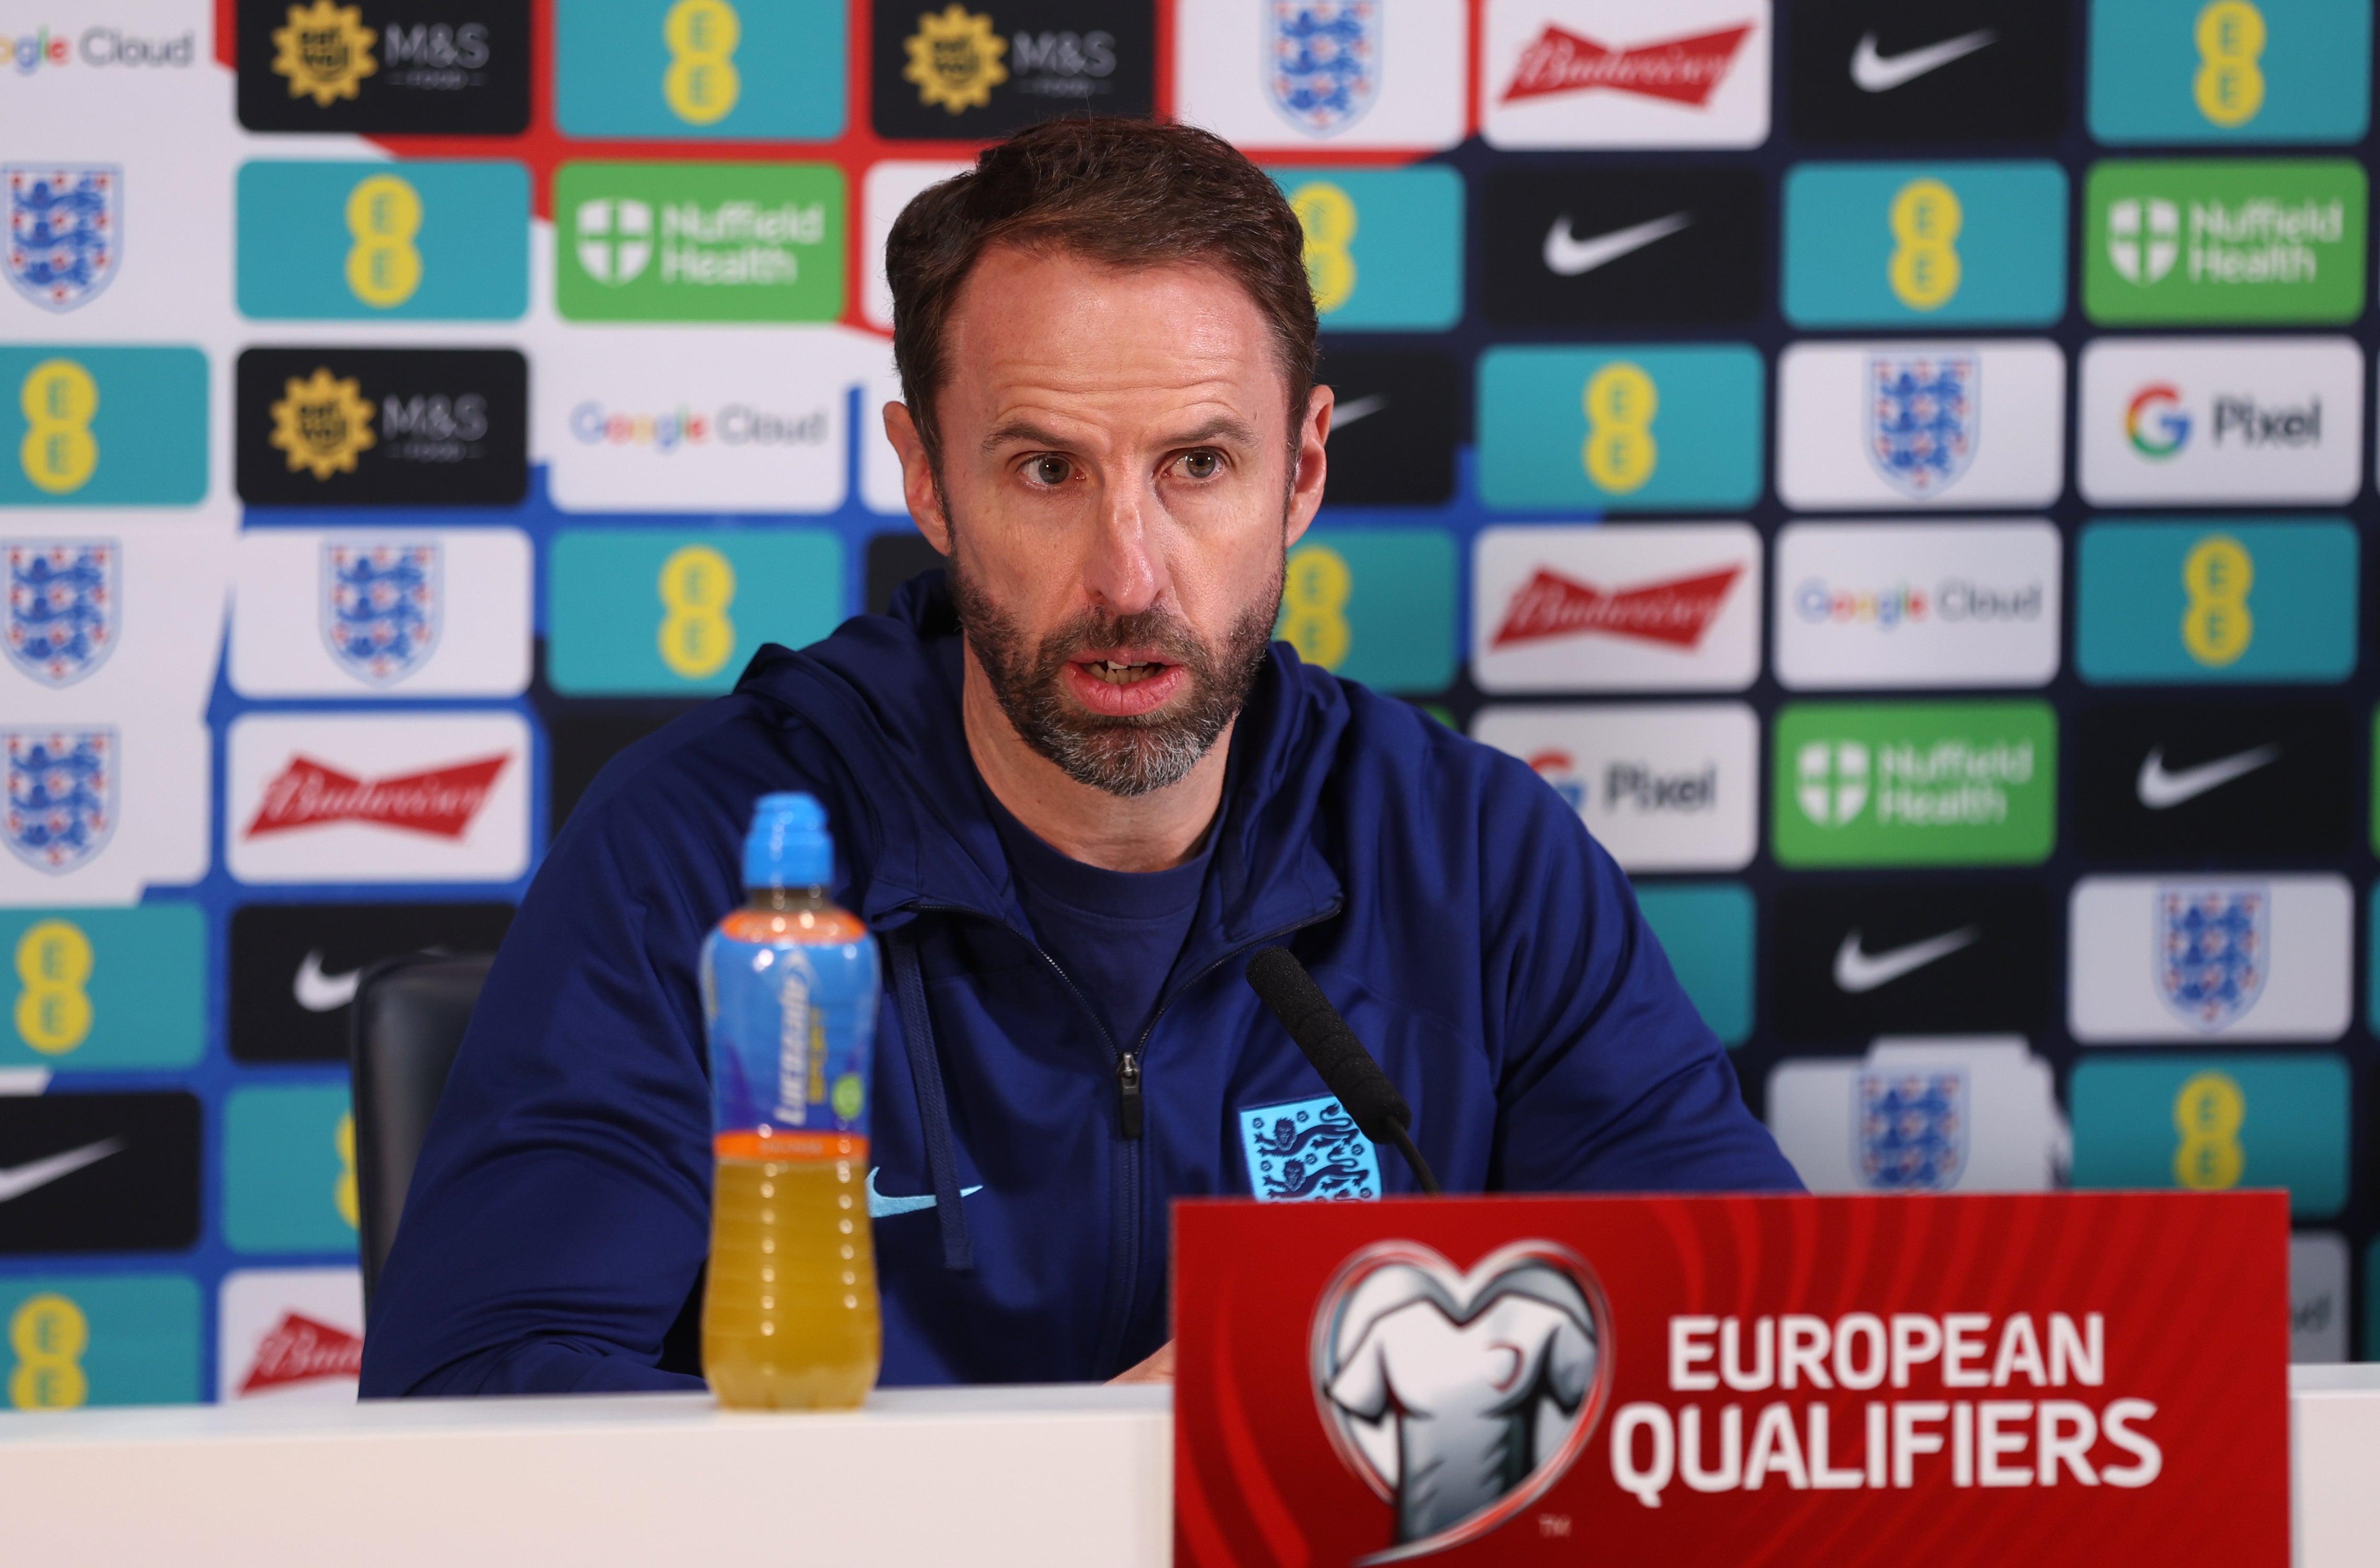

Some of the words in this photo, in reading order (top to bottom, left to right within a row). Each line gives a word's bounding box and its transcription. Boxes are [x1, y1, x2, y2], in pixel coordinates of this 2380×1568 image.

[80, 25, 194, 68] Cloud
[384, 21, 489, 68] M&S
[1012, 30, 1116, 77] M&S
[661, 201, 824, 244] Nuffield
[2188, 197, 2343, 242] Nuffield
[661, 245, 798, 285] Health
[2189, 243, 2316, 284] Health
[382, 393, 488, 441] M&S
[571, 402, 706, 453] Google
[718, 403, 826, 446] Cloud
[2211, 396, 2323, 448] Pixel
[1796, 577, 1927, 630] Google
[1938, 578, 2041, 622] Cloud
[1882, 738, 2033, 784] Nuffield
[1603, 760, 1718, 815] Pixel
[1881, 785, 2007, 825] Health
[1670, 1312, 2105, 1391] EUROPEAN
[1609, 1399, 2163, 1510] QUALIFIERS
